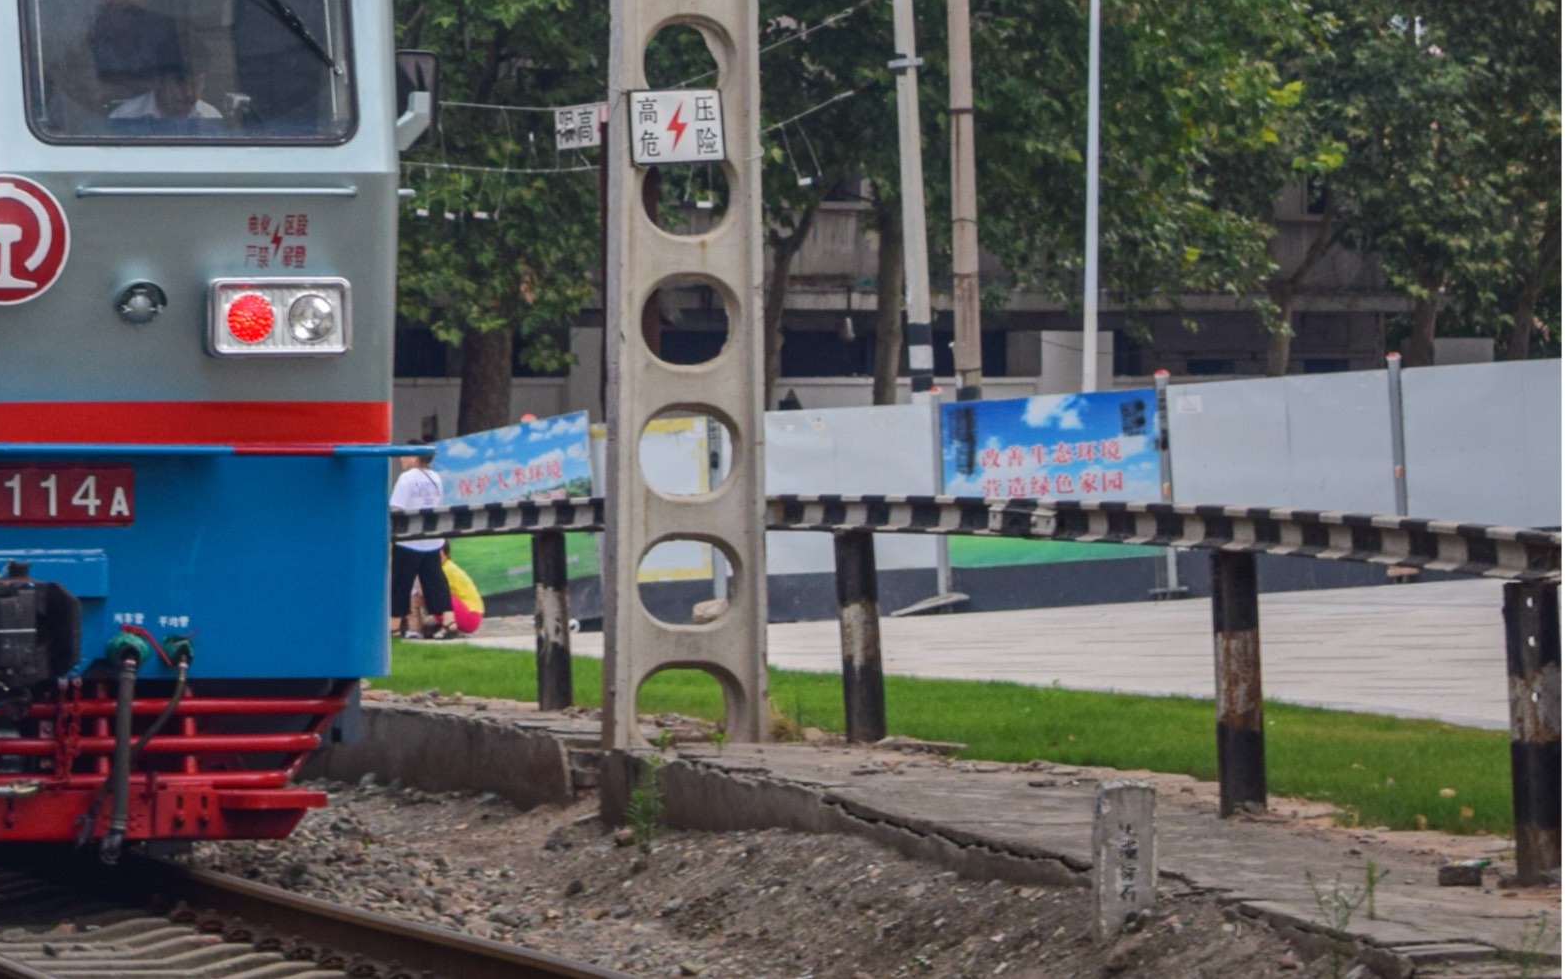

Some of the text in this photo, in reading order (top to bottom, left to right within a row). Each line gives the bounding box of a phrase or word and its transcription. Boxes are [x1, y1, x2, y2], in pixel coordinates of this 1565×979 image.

[981, 439, 1123, 468] 改善生态环境
[457, 458, 564, 497] 保护人类环境
[983, 472, 1124, 497] 营造绿色家园
